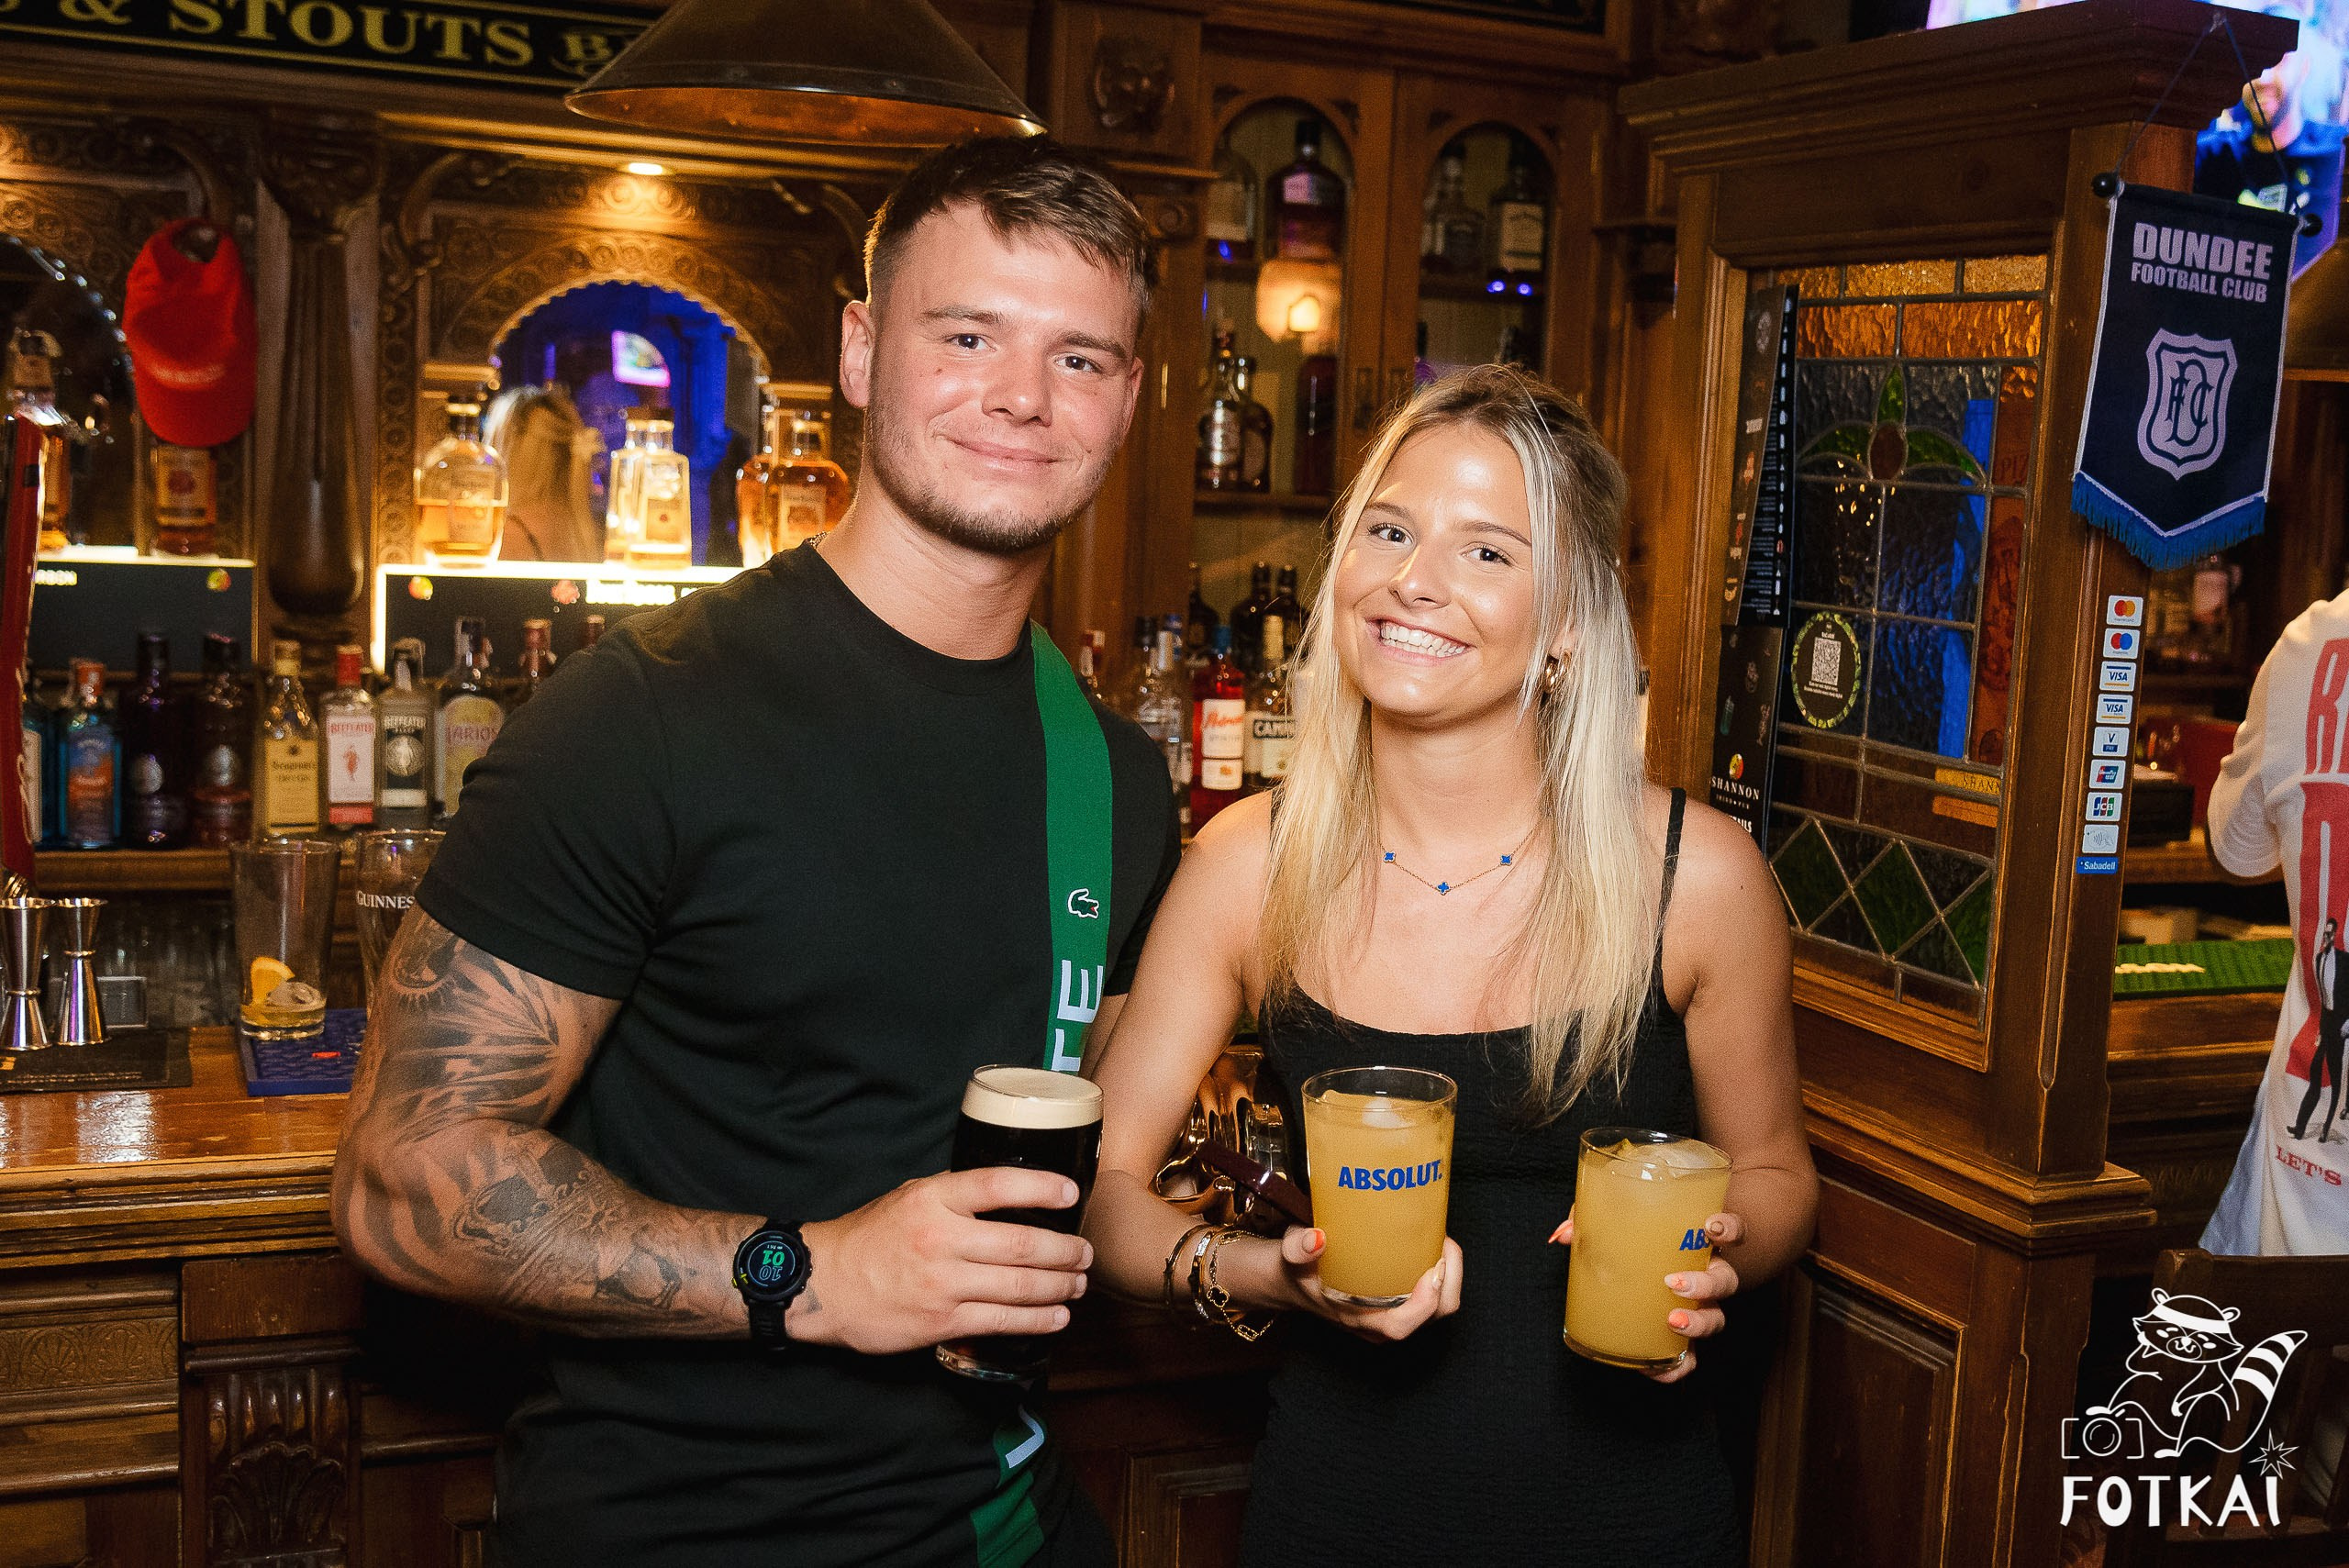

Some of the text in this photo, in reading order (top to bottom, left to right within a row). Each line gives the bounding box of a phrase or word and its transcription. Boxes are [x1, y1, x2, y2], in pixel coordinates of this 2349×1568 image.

[168, 0, 535, 68] STOUTS
[2132, 222, 2274, 280] DUNDEE
[2131, 261, 2267, 304] FOOTBALL CLUB
[2109, 671, 2128, 681] VISA
[2106, 703, 2124, 713] VISA
[1711, 775, 1760, 801] SHANNON
[2084, 860, 2116, 871] Sabadell
[2277, 1144, 2342, 1187] LET'S
[1678, 1228, 1709, 1251] AB
[761, 1250, 785, 1265] 01
[759, 1265, 784, 1282] 10
